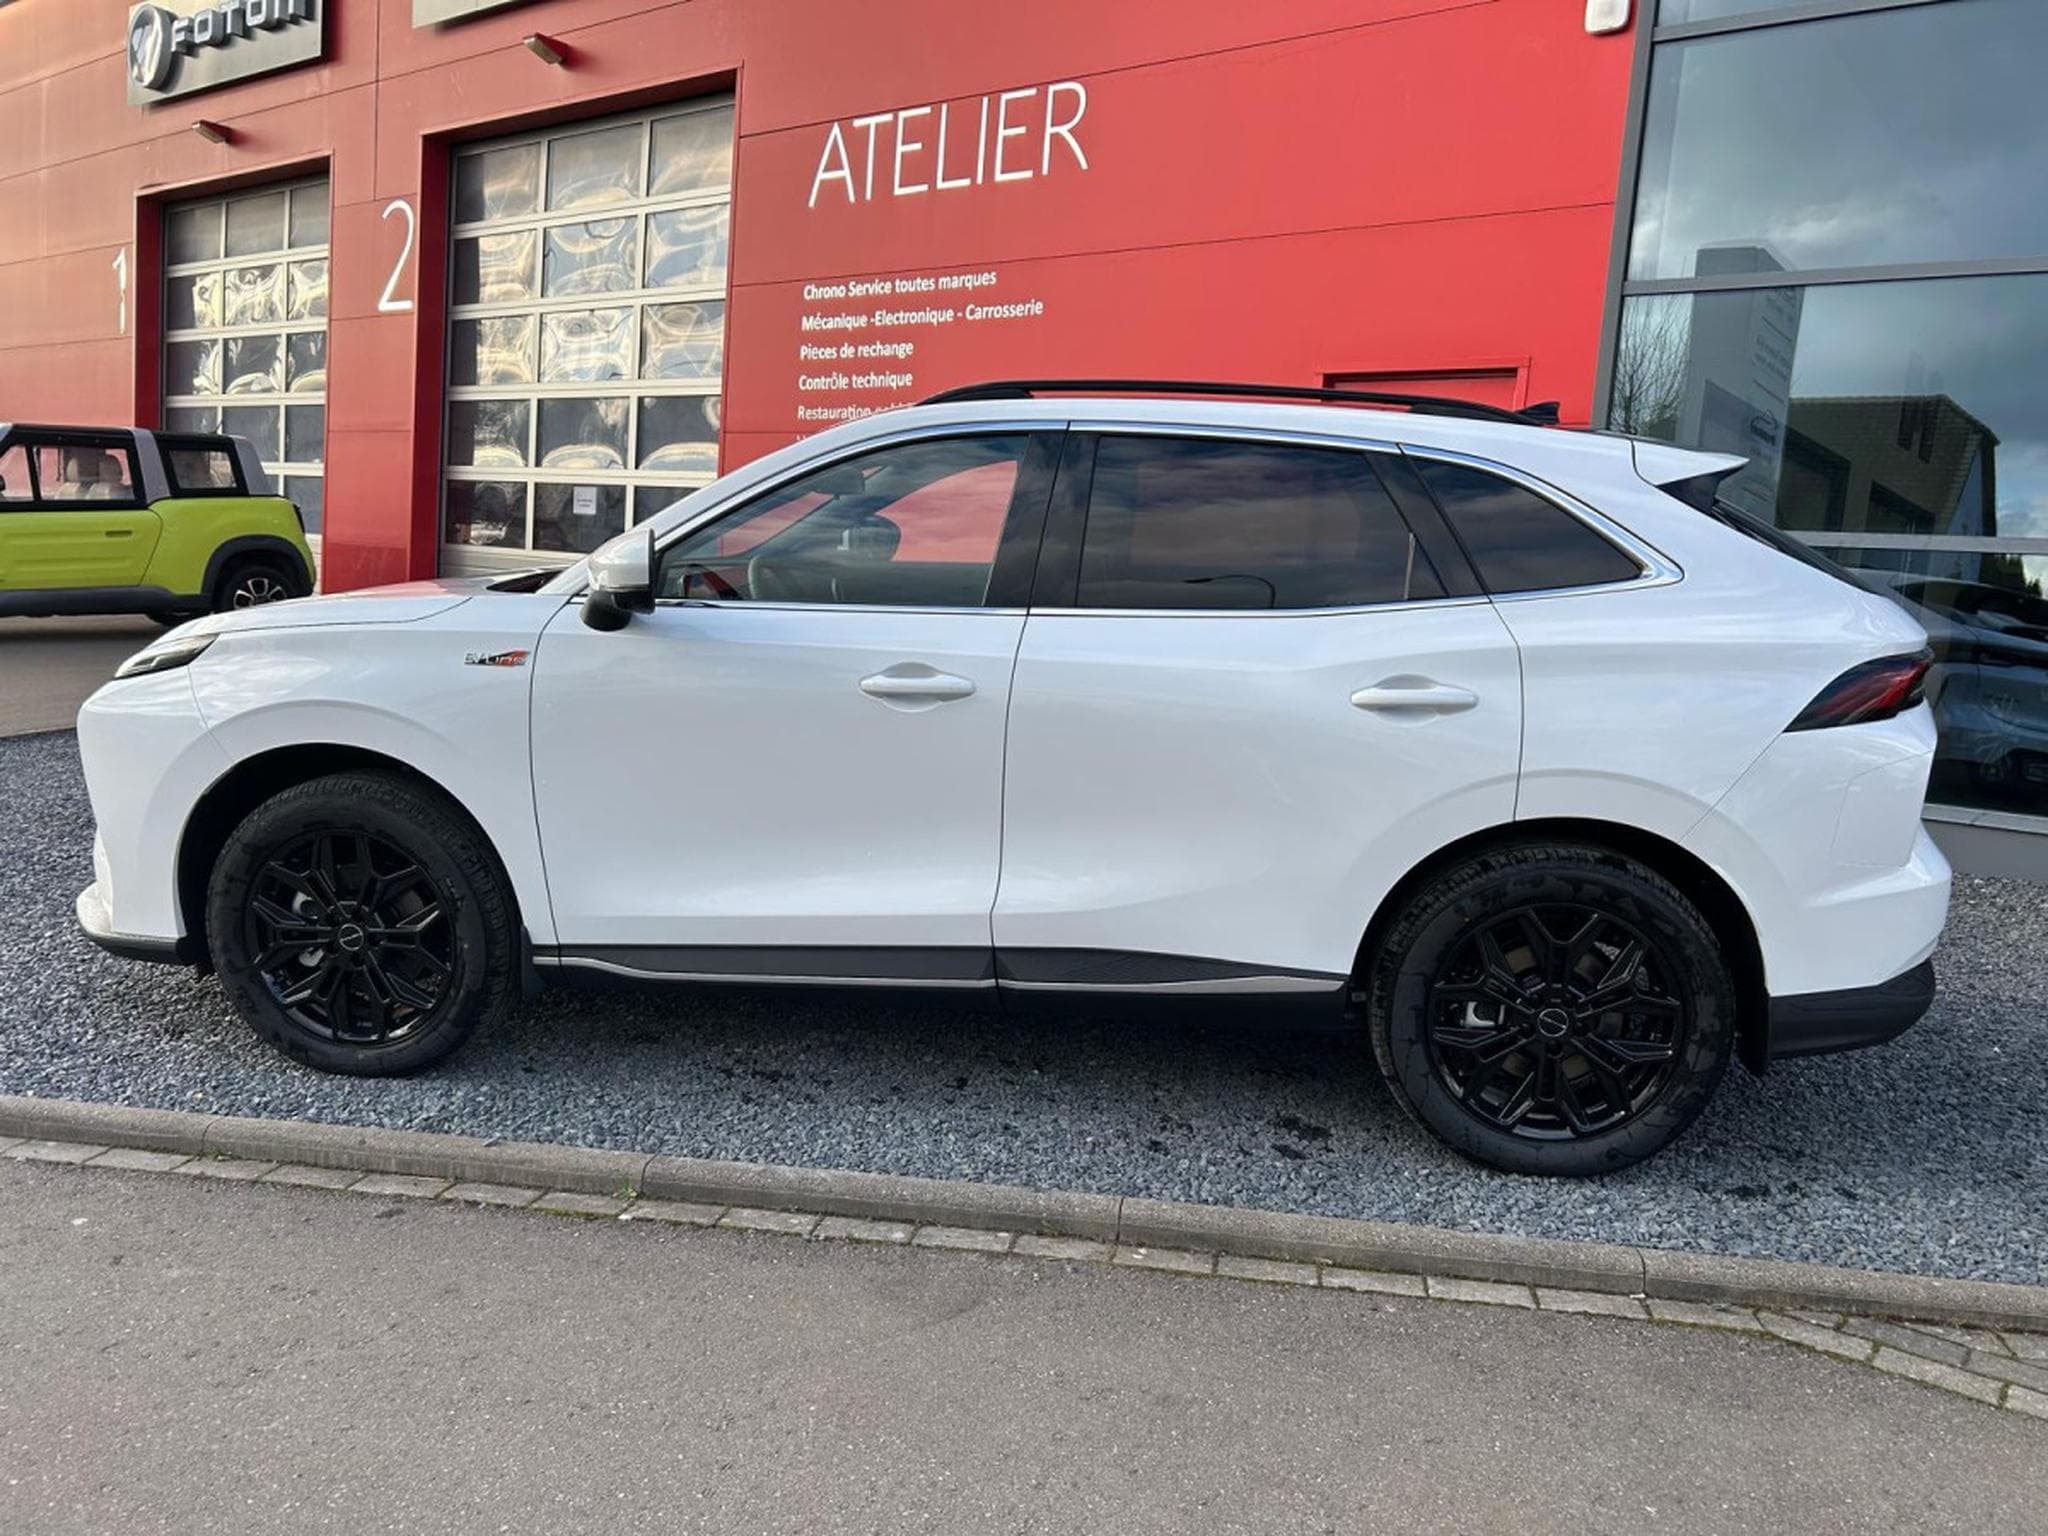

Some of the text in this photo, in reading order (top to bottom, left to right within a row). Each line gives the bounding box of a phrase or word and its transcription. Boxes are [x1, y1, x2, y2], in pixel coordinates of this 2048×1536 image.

[808, 80, 1089, 209] ATELIER
[378, 199, 415, 312] 2
[112, 247, 127, 335] 1
[803, 271, 997, 301] Chrono Service toutes marques
[801, 311, 868, 331] Mécanique
[965, 298, 1044, 321] Carrosserie
[840, 341, 856, 359] de
[857, 340, 914, 360] rechange
[799, 369, 913, 391] Contrôle technique
[798, 403, 873, 422] Restauration
